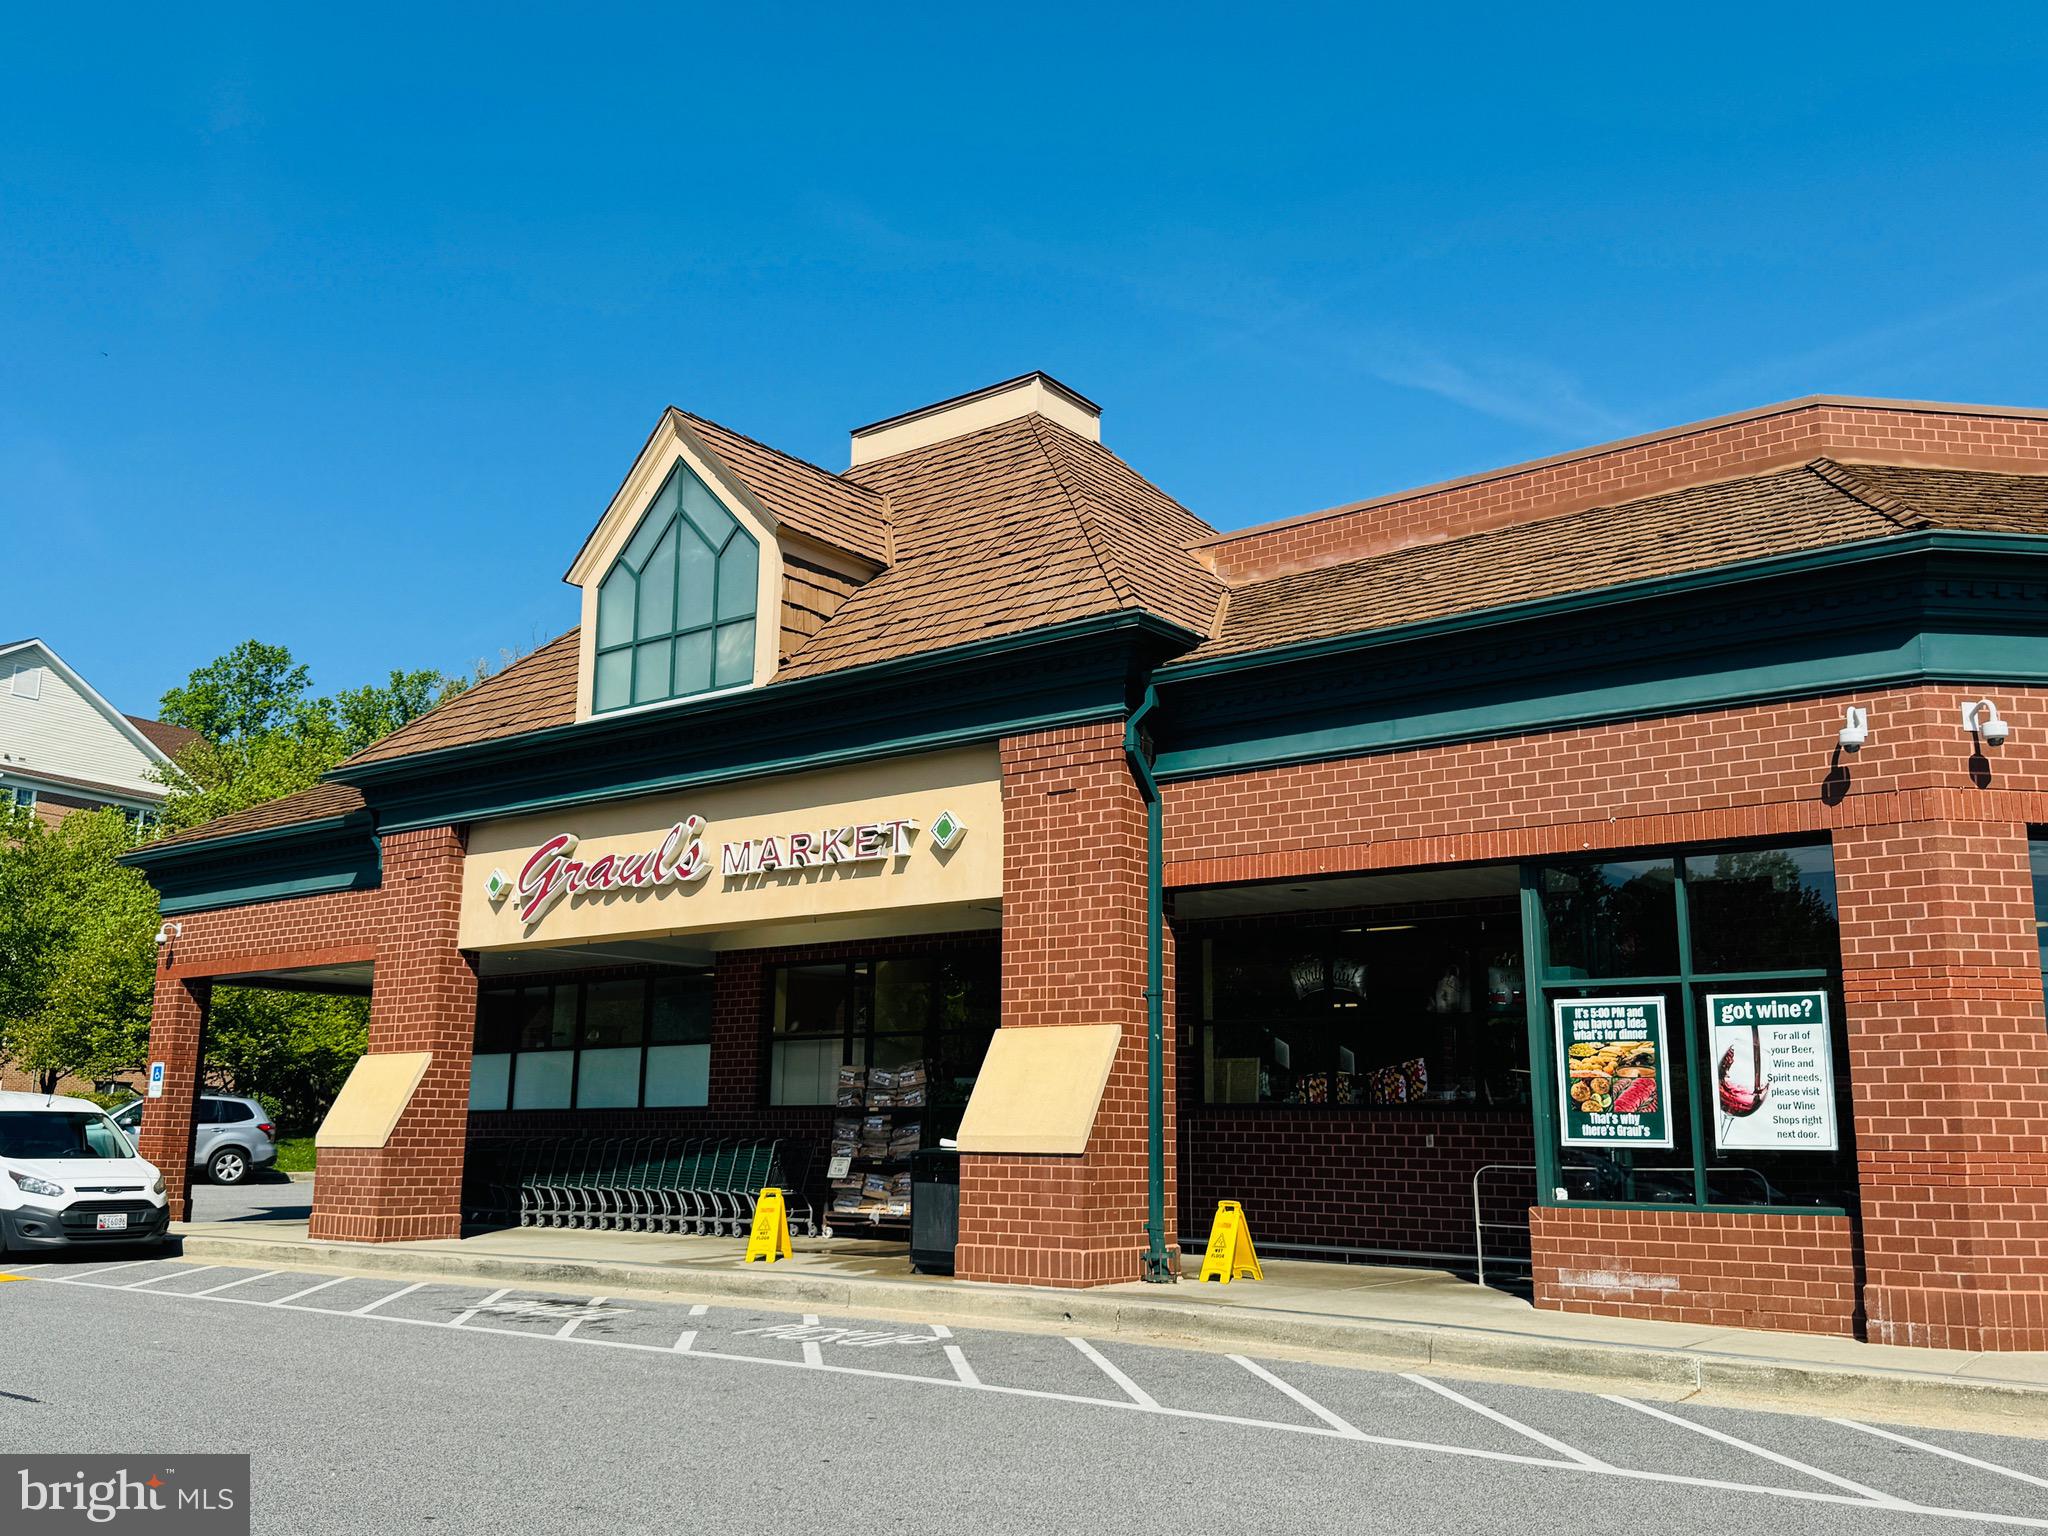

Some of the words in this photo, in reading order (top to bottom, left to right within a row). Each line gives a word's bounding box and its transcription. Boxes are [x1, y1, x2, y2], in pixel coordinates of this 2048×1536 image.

[518, 814, 712, 924] Graul's
[721, 819, 917, 876] MARKET
[1574, 1008, 1589, 1019] It's
[1590, 1007, 1610, 1018] 5:00
[1611, 1007, 1625, 1018] PM
[1626, 1006, 1644, 1017] and
[1721, 1002, 1753, 1023] got
[1757, 998, 1813, 1019] wine?
[1573, 1019, 1589, 1030] you
[1591, 1018, 1612, 1029] have
[1614, 1019, 1626, 1029] no
[1627, 1018, 1647, 1029] idea
[1573, 1030, 1603, 1041] what's
[1604, 1030, 1617, 1040] for
[1618, 1029, 1648, 1040] dinner
[1773, 1031, 1787, 1040] For
[1789, 1031, 1800, 1040] all
[1801, 1030, 1811, 1040] of
[1771, 1047, 1789, 1056] your
[1791, 1045, 1815, 1055] Beer,
[1773, 1059, 1795, 1068] Wine
[1797, 1059, 1814, 1068] and
[1767, 1073, 1791, 1083] Spirit
[1792, 1073, 1822, 1083] needs,
[1771, 1087, 1800, 1098] please
[1801, 1087, 1820, 1096] visit
[1793, 1101, 1816, 1110] Wine
[1589, 1112, 1619, 1124] That's
[1619, 1112, 1641, 1126] why
[1772, 1115, 1800, 1126] Shops
[1801, 1115, 1823, 1126] right
[1581, 1124, 1615, 1136] there's
[1616, 1124, 1651, 1137] Graul's
[1777, 1130, 1796, 1139] next
[1797, 1130, 1820, 1139] door.
[731, 1324, 941, 1347] PICKUP
